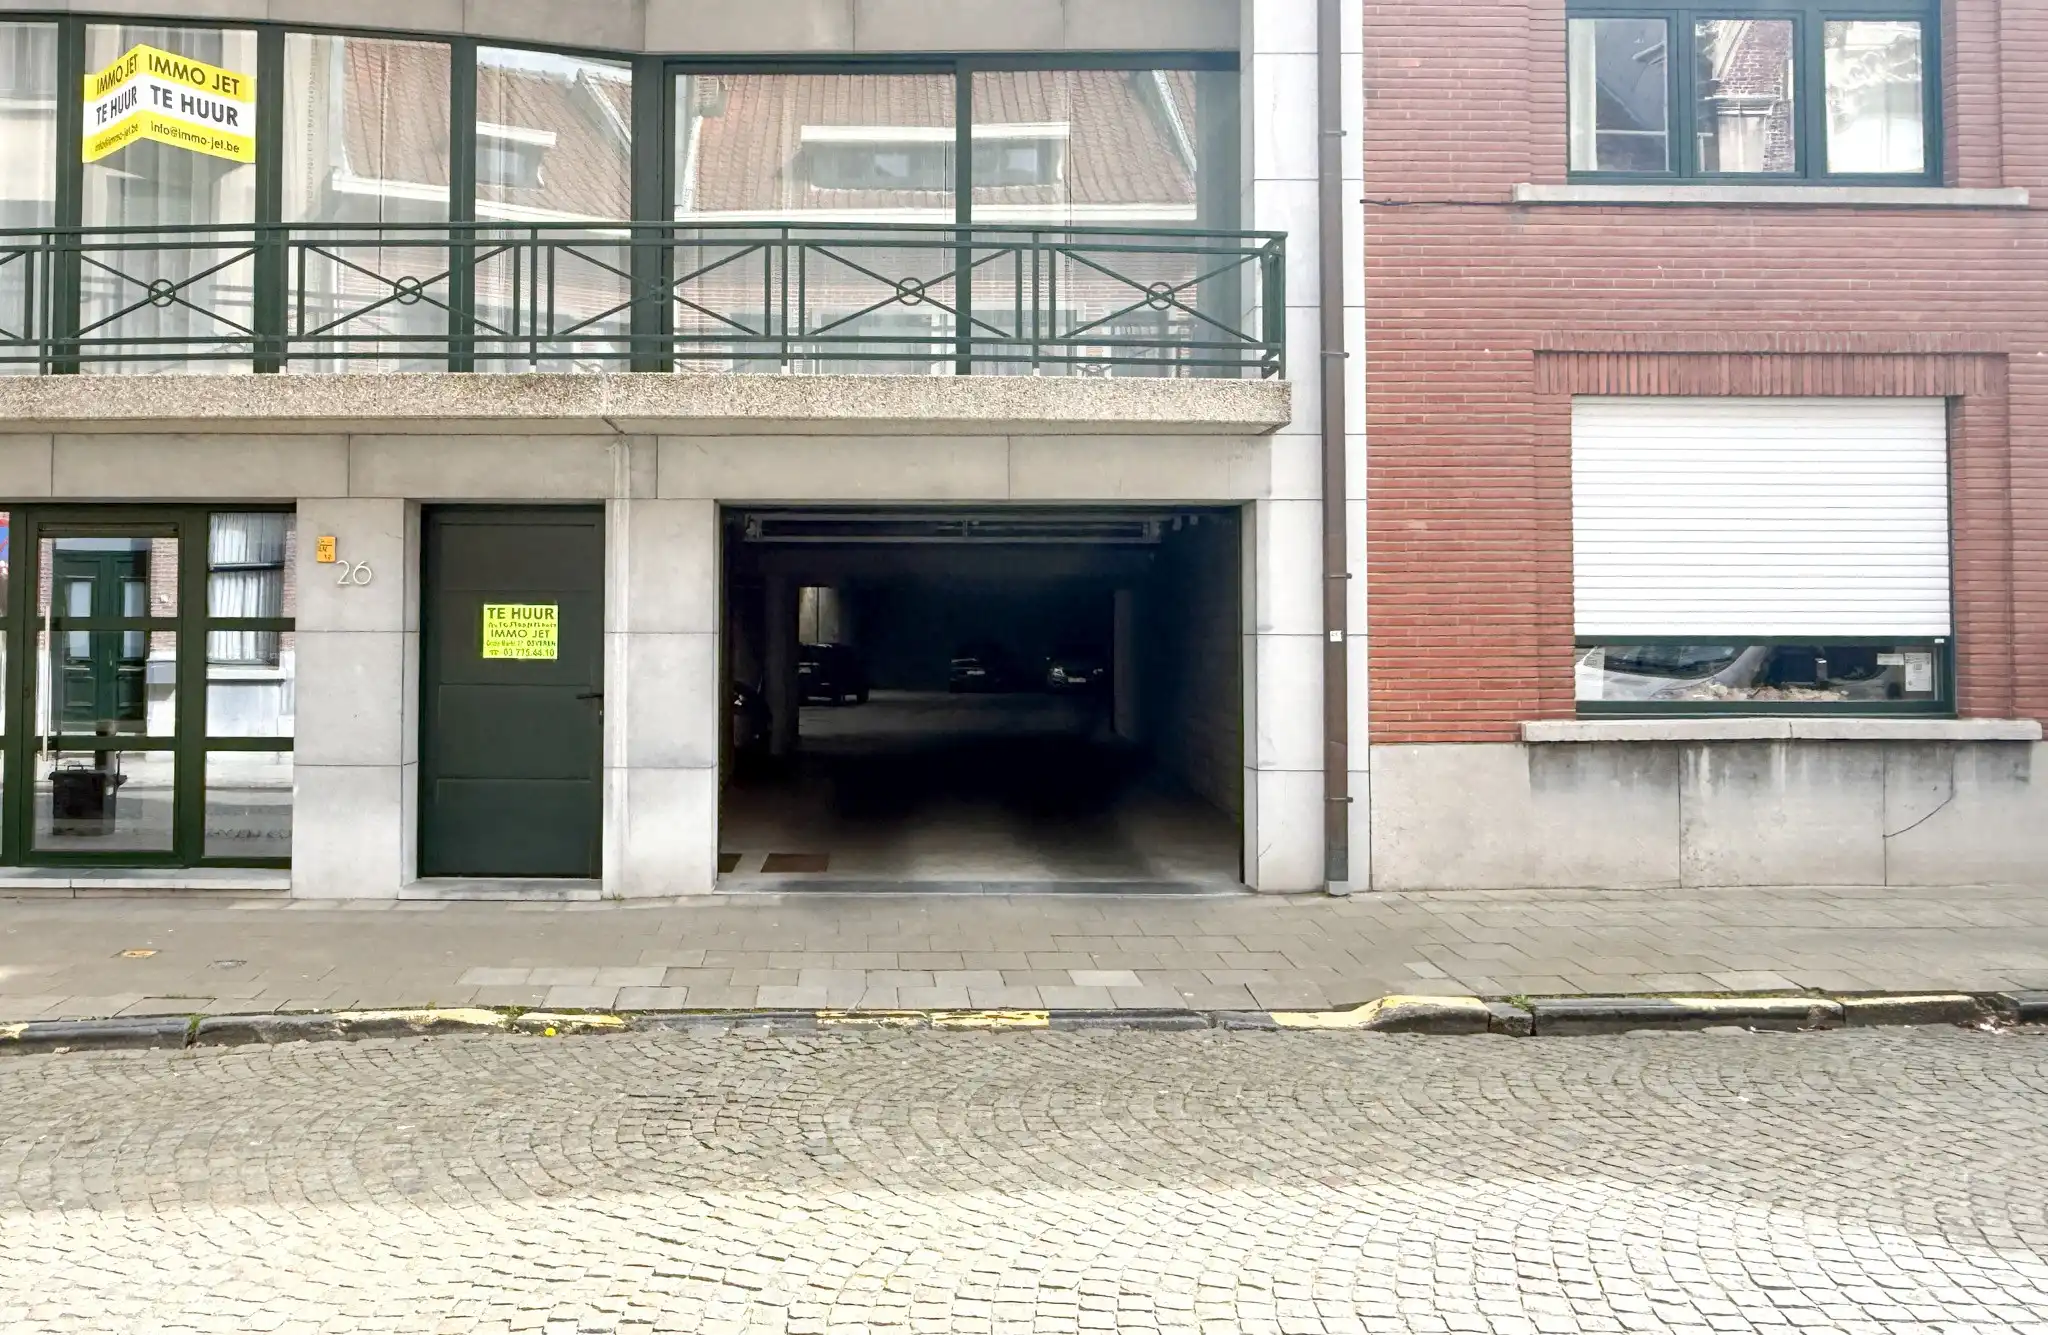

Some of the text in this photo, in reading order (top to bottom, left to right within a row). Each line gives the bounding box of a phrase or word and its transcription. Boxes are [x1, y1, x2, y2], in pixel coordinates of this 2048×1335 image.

[97, 53, 139, 96] IMMO JET
[148, 53, 240, 95] IMMO JET
[96, 86, 138, 126] TE HUUR
[150, 84, 239, 127] TE HUUR
[151, 120, 240, 154] info@immo-jet.be
[336, 560, 372, 585] 26
[487, 607, 554, 620] TE HUUR
[490, 629, 550, 638] IMMO JET
